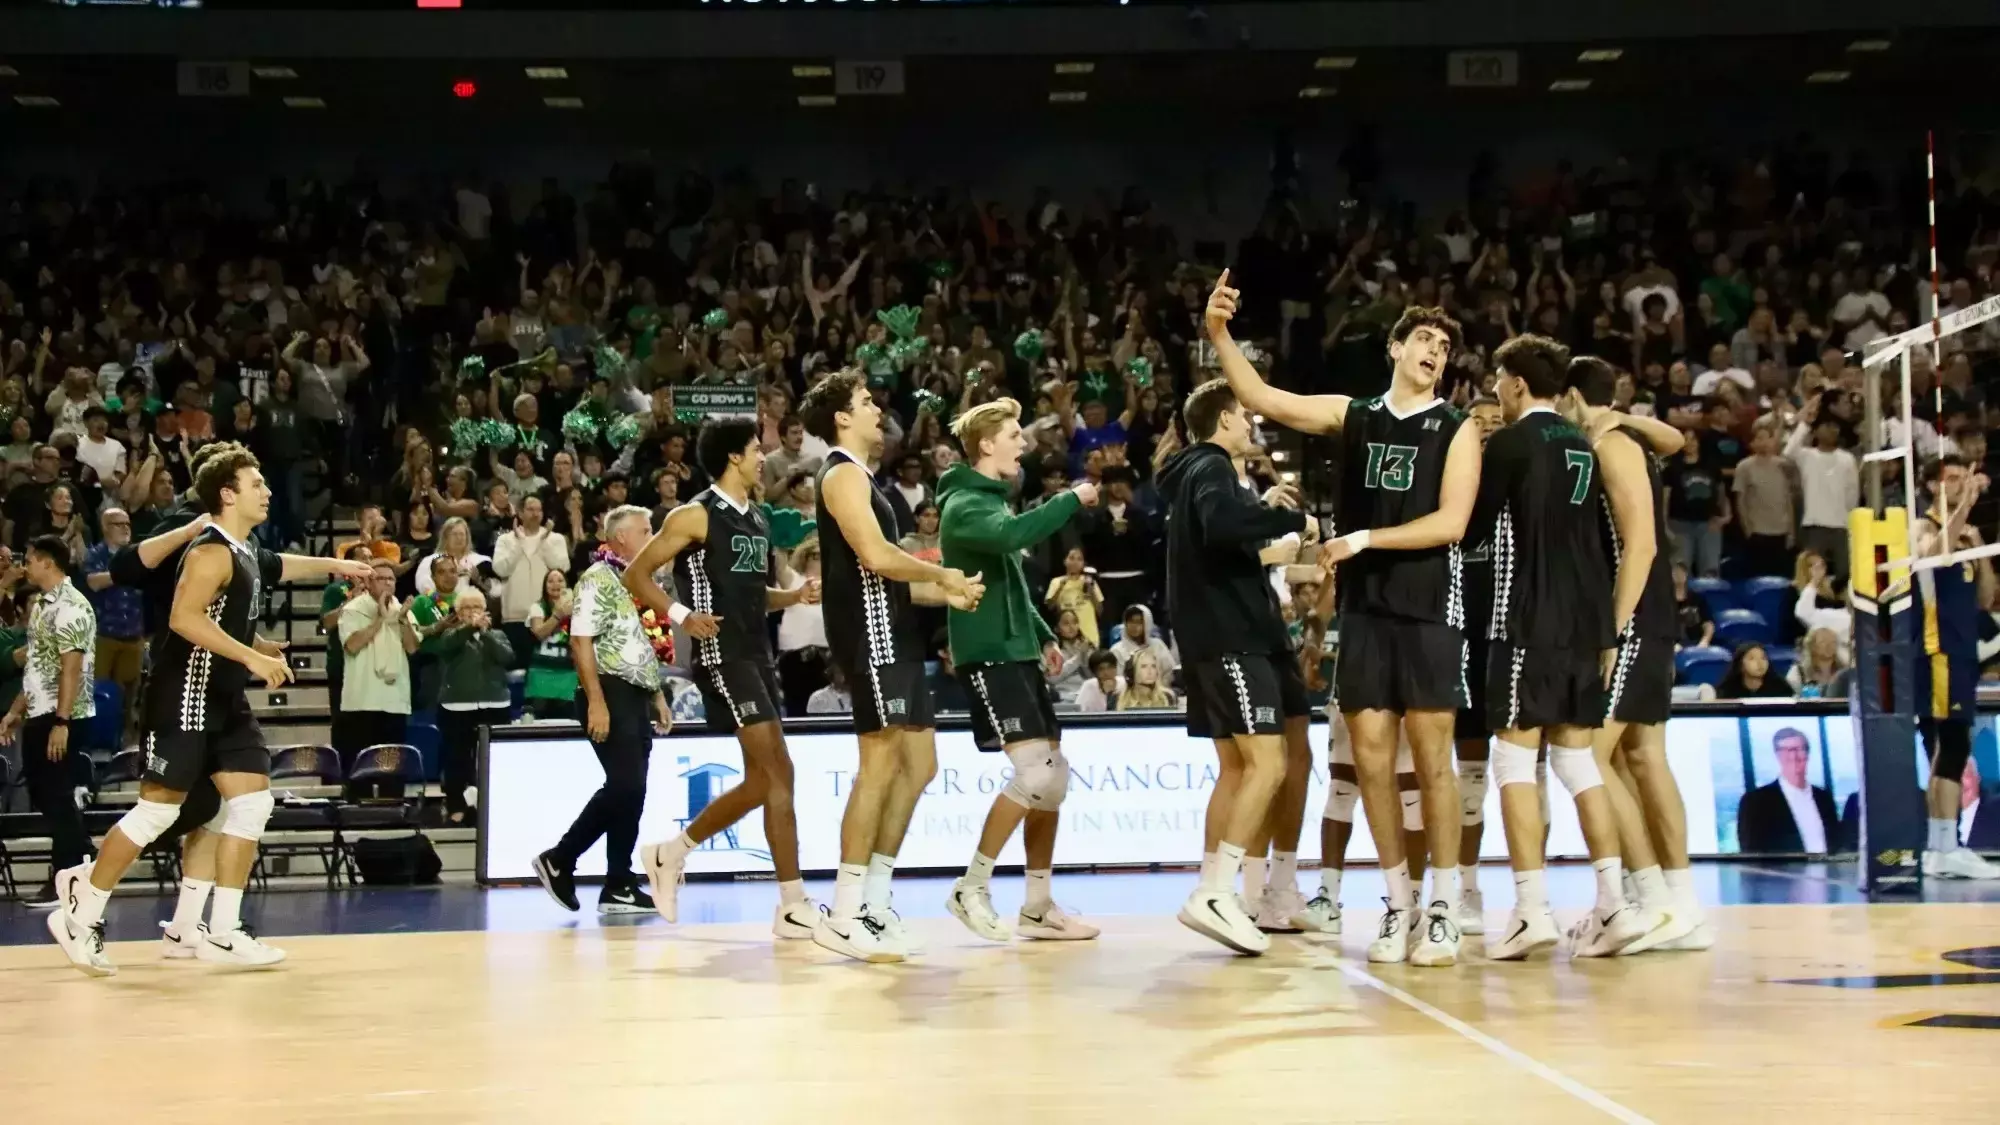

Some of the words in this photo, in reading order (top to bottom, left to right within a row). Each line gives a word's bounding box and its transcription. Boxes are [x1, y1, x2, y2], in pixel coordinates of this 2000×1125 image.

[456, 83, 473, 97] EXIT
[854, 65, 886, 91] 119
[691, 393, 708, 404] GO
[1365, 442, 1419, 491] 13
[1565, 448, 1593, 505] 7
[730, 534, 769, 573] 20
[1069, 763, 1218, 792] NANCIA
[1072, 810, 1102, 832] IN
[1111, 808, 1204, 832] WEALT
